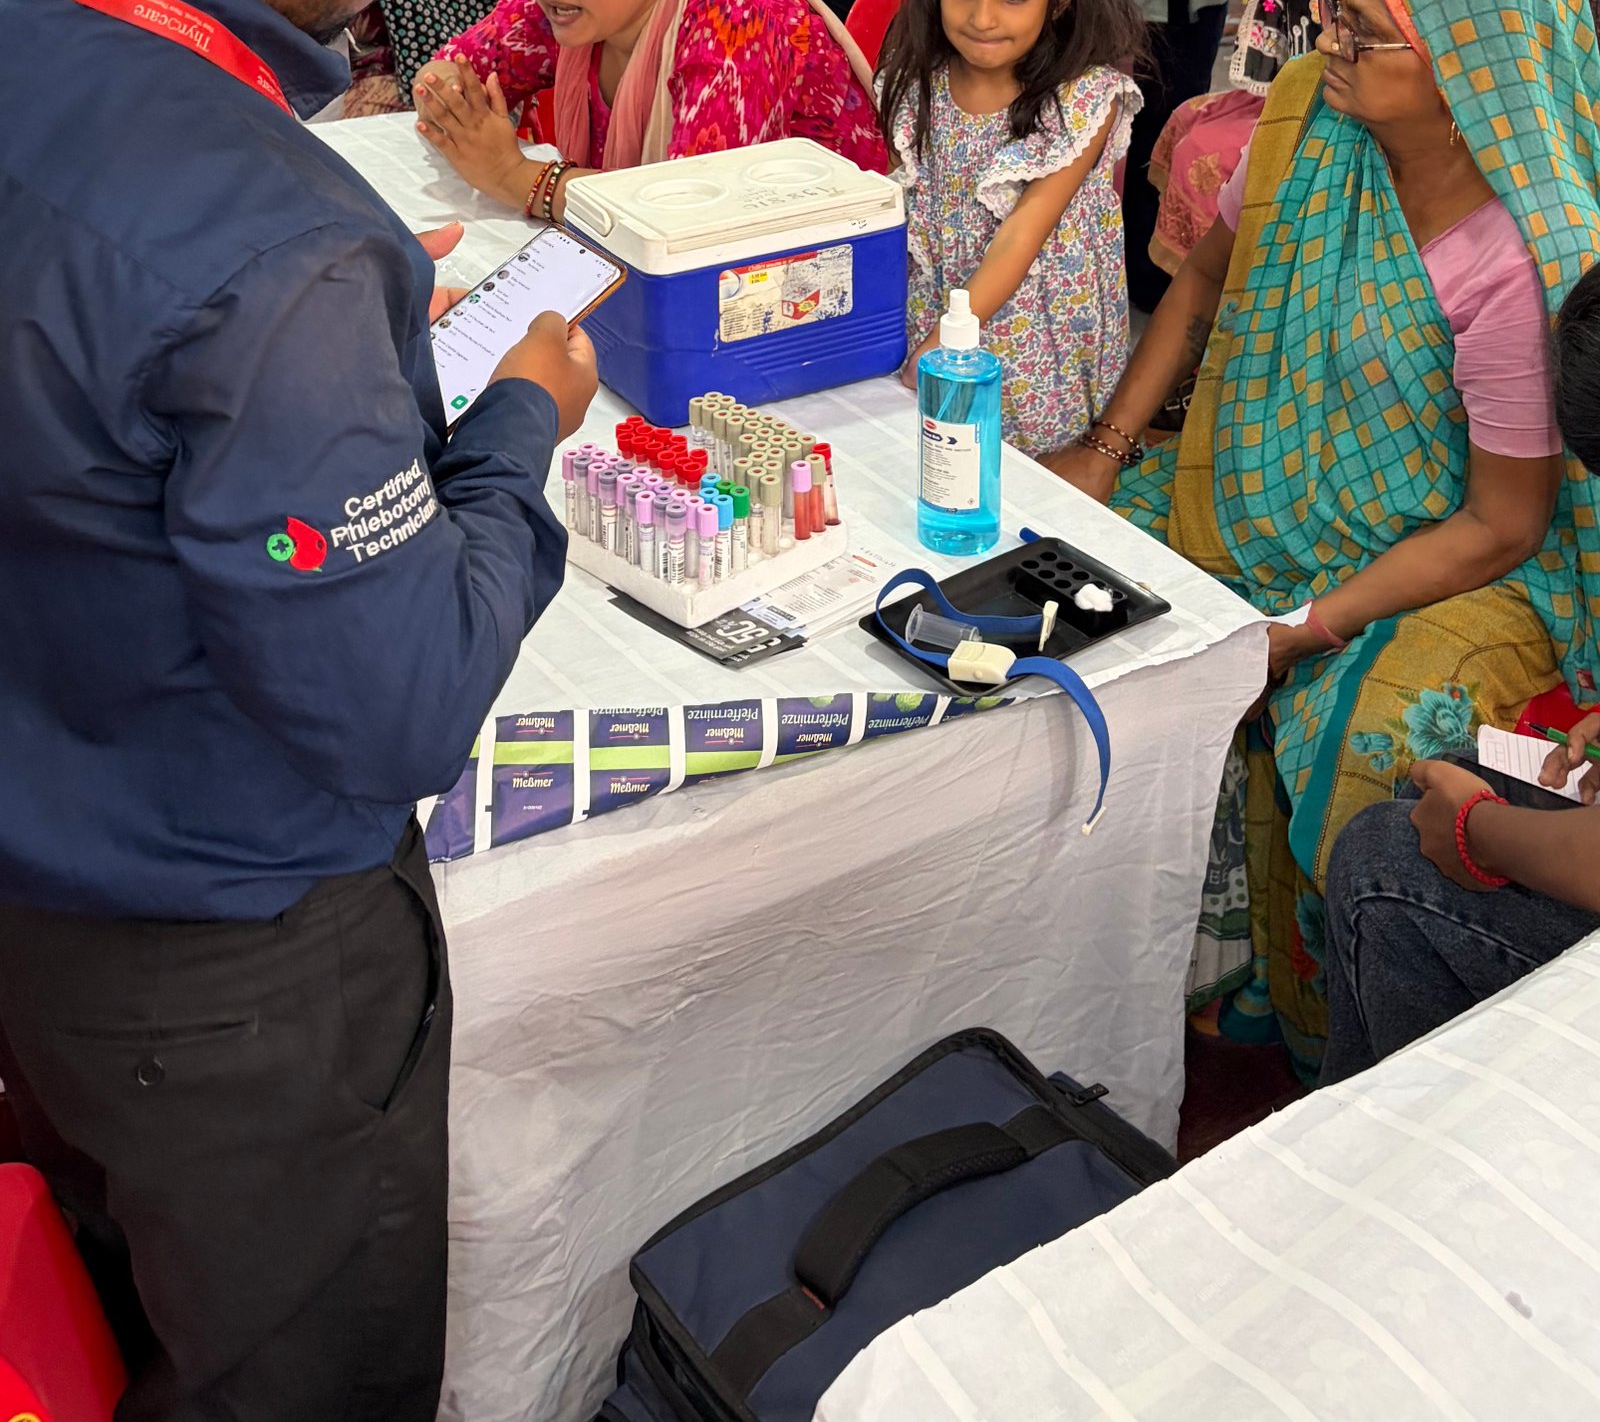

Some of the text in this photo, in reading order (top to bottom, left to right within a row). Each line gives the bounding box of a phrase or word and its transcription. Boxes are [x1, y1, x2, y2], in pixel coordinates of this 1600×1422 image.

[134, 4, 211, 52] Thyrocare
[344, 458, 422, 517] Certified
[330, 475, 431, 547] Phlebotomy
[687, 707, 759, 720] Pfefferminze
[782, 713, 850, 726] Pfefferminze
[517, 717, 555, 728] Meßmer
[610, 722, 649, 733] Meßmer
[868, 715, 930, 729] Pfefferminze
[705, 727, 744, 738] Meßmer
[796, 732, 832, 743] Meßmer
[513, 777, 553, 788] Meßmer
[610, 782, 650, 793] Meßmer
